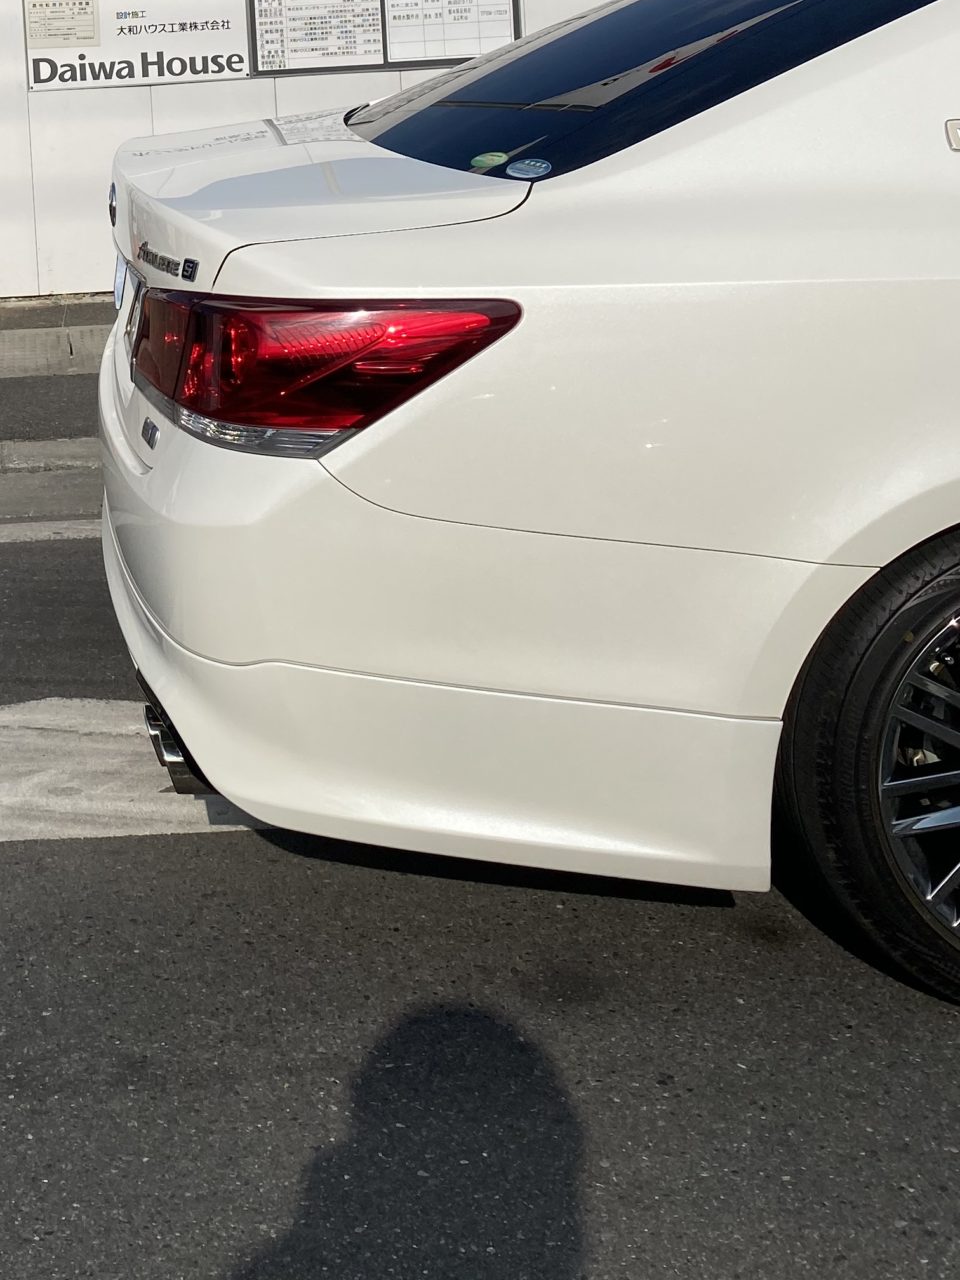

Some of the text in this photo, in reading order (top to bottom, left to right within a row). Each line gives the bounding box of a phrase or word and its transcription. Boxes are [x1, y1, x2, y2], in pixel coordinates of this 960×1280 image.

[116, 19, 232, 37] 大和ハウス工業株式会社
[31, 50, 245, 85] Daiwa House
